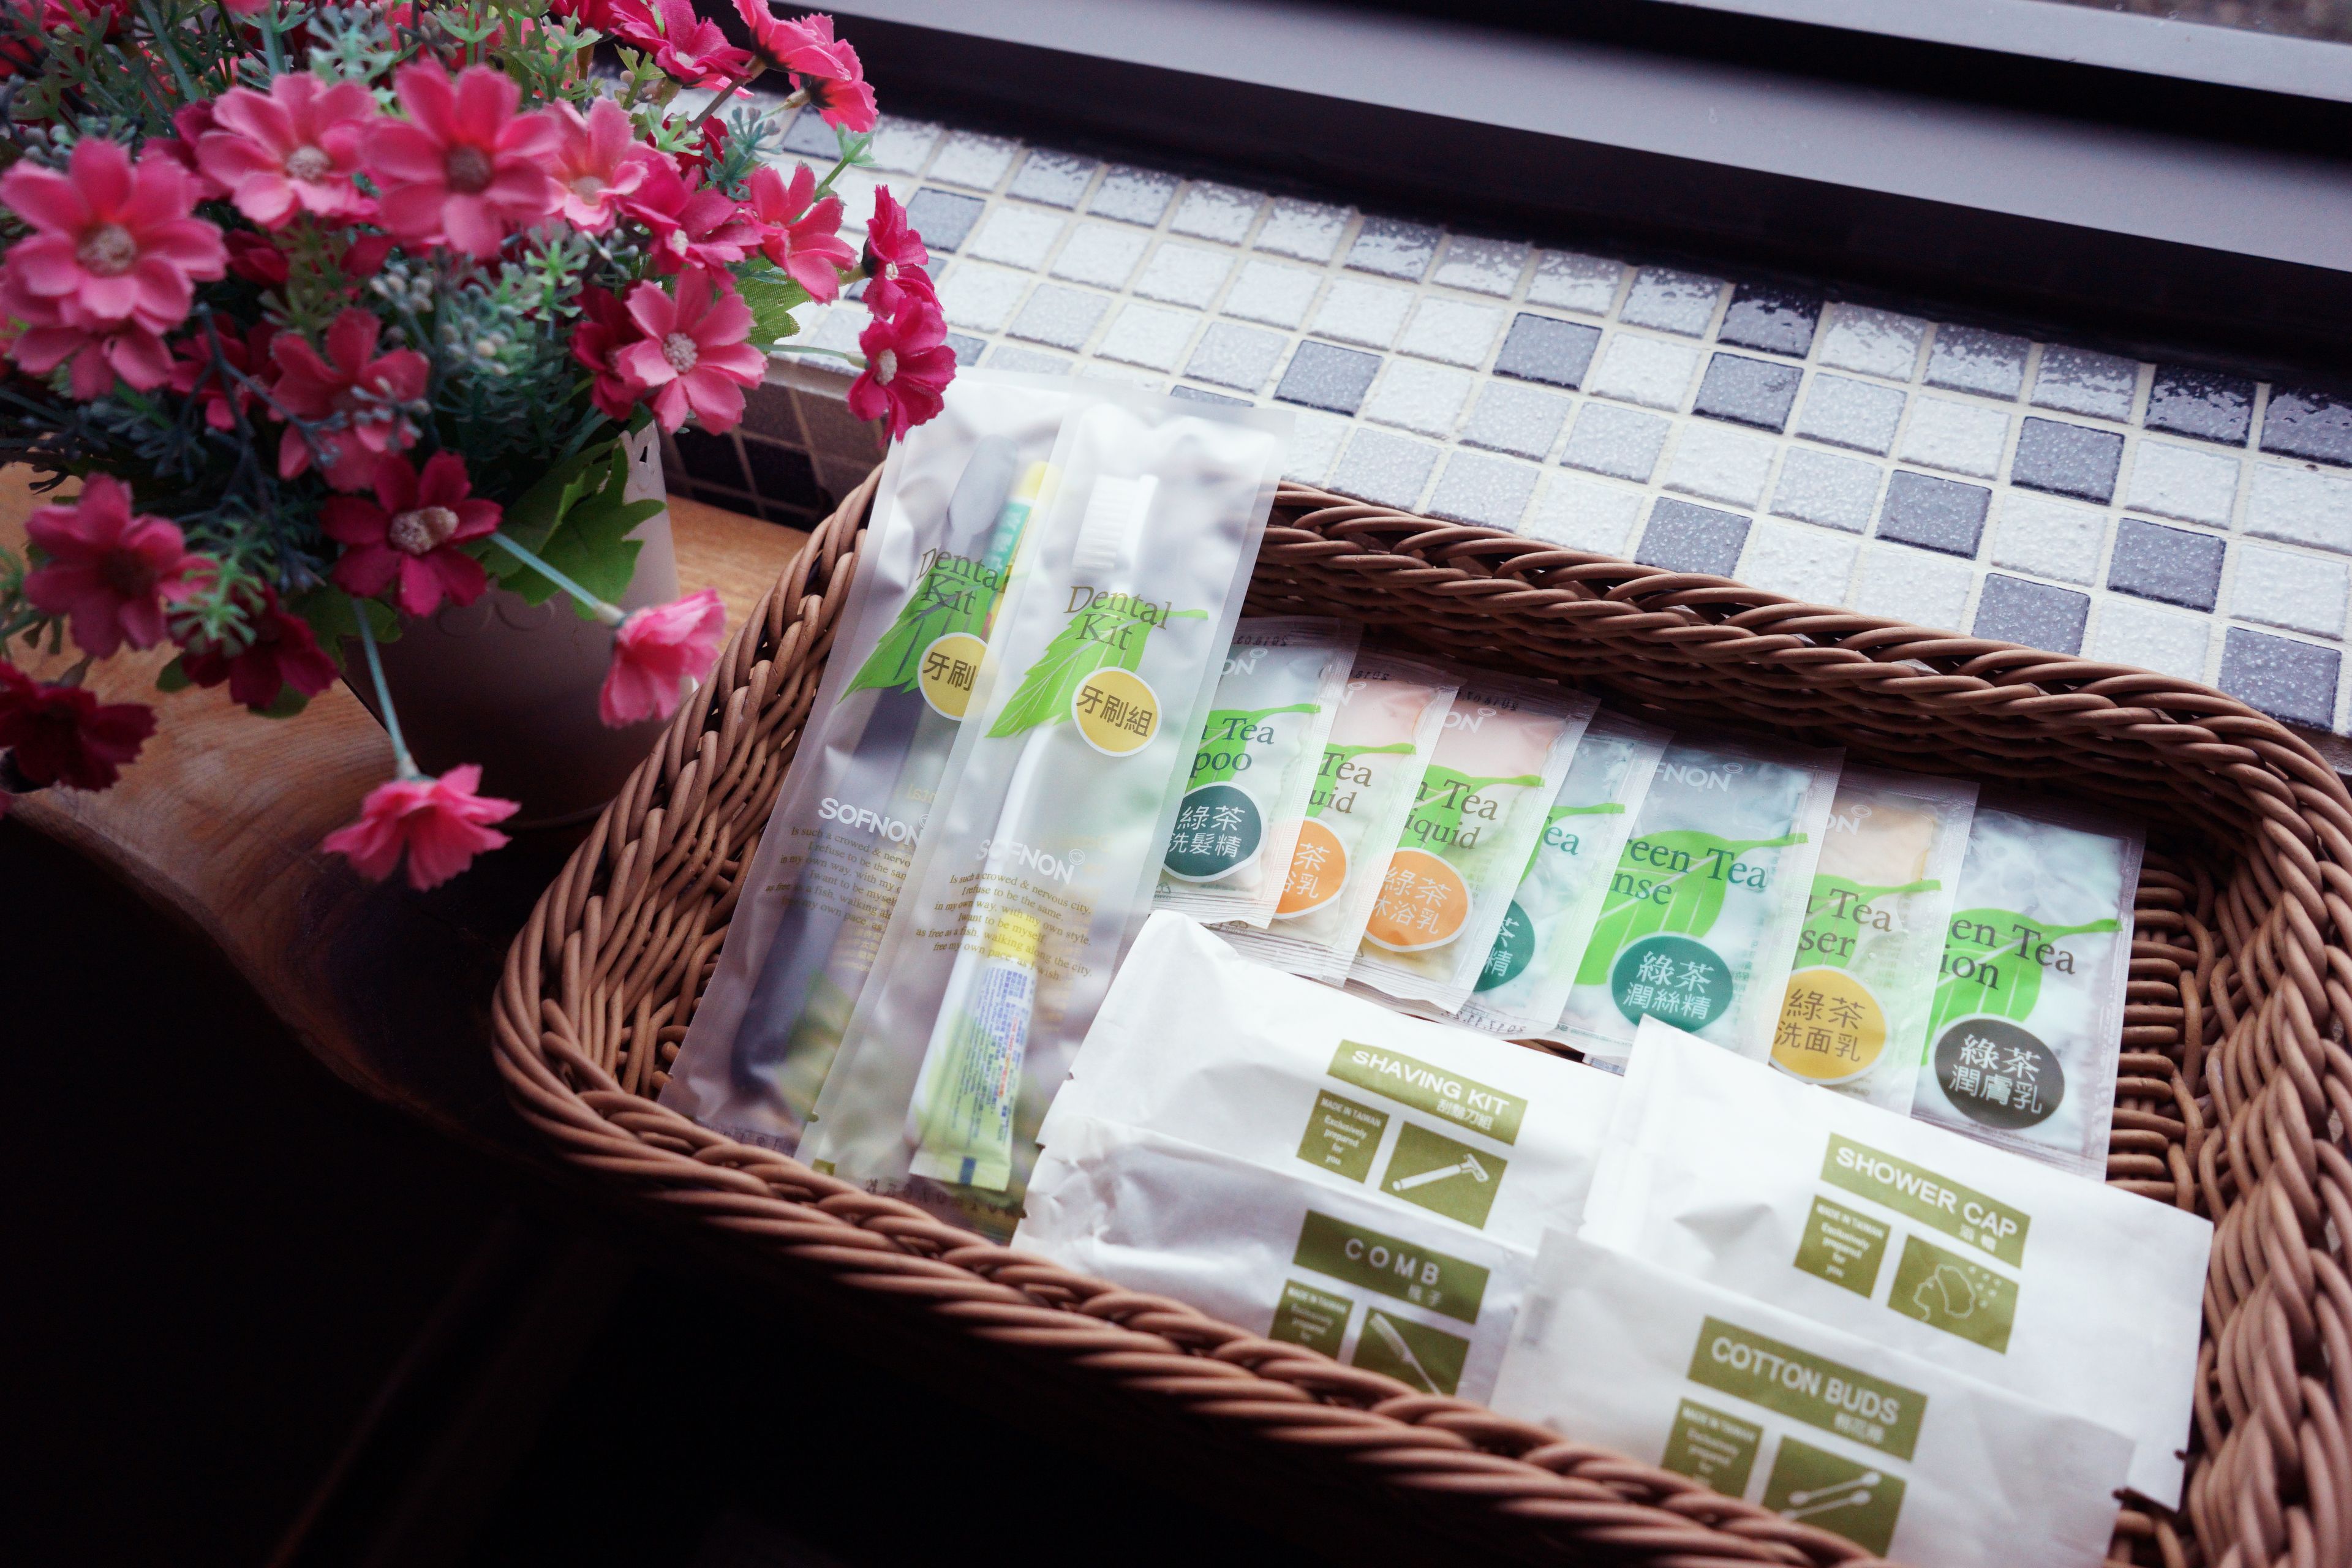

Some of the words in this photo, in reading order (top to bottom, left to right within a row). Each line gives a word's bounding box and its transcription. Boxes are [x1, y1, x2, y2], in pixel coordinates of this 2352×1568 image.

[917, 548, 1012, 594] Dental
[921, 574, 978, 615] Kit
[1064, 586, 1172, 630] Dental
[1076, 613, 1133, 650] Kit
[922, 652, 978, 692] 牙刷
[1076, 685, 1153, 737] 牙刷組
[1222, 717, 1275, 745] Tea
[1317, 751, 1373, 788] Tea
[1177, 804, 1246, 832] 綠茶
[1441, 778, 1499, 821] Tea
[818, 797, 919, 848] SOFNON
[1404, 807, 1481, 850] iquid
[1543, 816, 1580, 856] ea
[856, 870, 876, 884] with
[879, 880, 895, 892] my
[873, 862, 889, 873] the
[1621, 838, 1691, 874] een
[1706, 848, 1768, 890] Tea
[981, 872, 1018, 886] crowed
[1020, 879, 1030, 891] &
[1032, 886, 1069, 907] nervous
[993, 887, 1004, 897] to
[1006, 889, 1019, 901] be
[1021, 895, 1036, 908] the
[1384, 866, 1452, 908] 綠茶
[934, 900, 944, 911] in
[1001, 905, 1023, 919] with
[1025, 913, 1041, 927] my
[1042, 922, 1064, 937] own
[984, 916, 995, 926] to
[997, 918, 1010, 930] be
[1829, 888, 1892, 933] Tea
[916, 928, 927, 937] as
[984, 931, 1023, 952] walking
[1025, 945, 1053, 965] along
[1054, 956, 1070, 969] the
[963, 944, 986, 954] own
[2011, 923, 2076, 975] Tea
[1636, 951, 1714, 995] 綠茶
[1623, 982, 1713, 1020] 潤絲精
[1786, 989, 1866, 1030] 綠茶
[1775, 1020, 1863, 1063] 洗面乳
[1959, 1033, 2043, 1082] 綠茶
[1352, 1049, 1463, 1100] SHAVING
[1464, 1088, 1510, 1117] KIT
[1948, 1063, 2043, 1115] 潤膚乳
[1836, 1147, 1958, 1215] SHOWER
[1963, 1201, 2018, 1238] CAP
[1344, 1238, 1442, 1286] COMB
[1711, 1336, 1822, 1397] COTTON
[1824, 1377, 1900, 1426] BUDS
